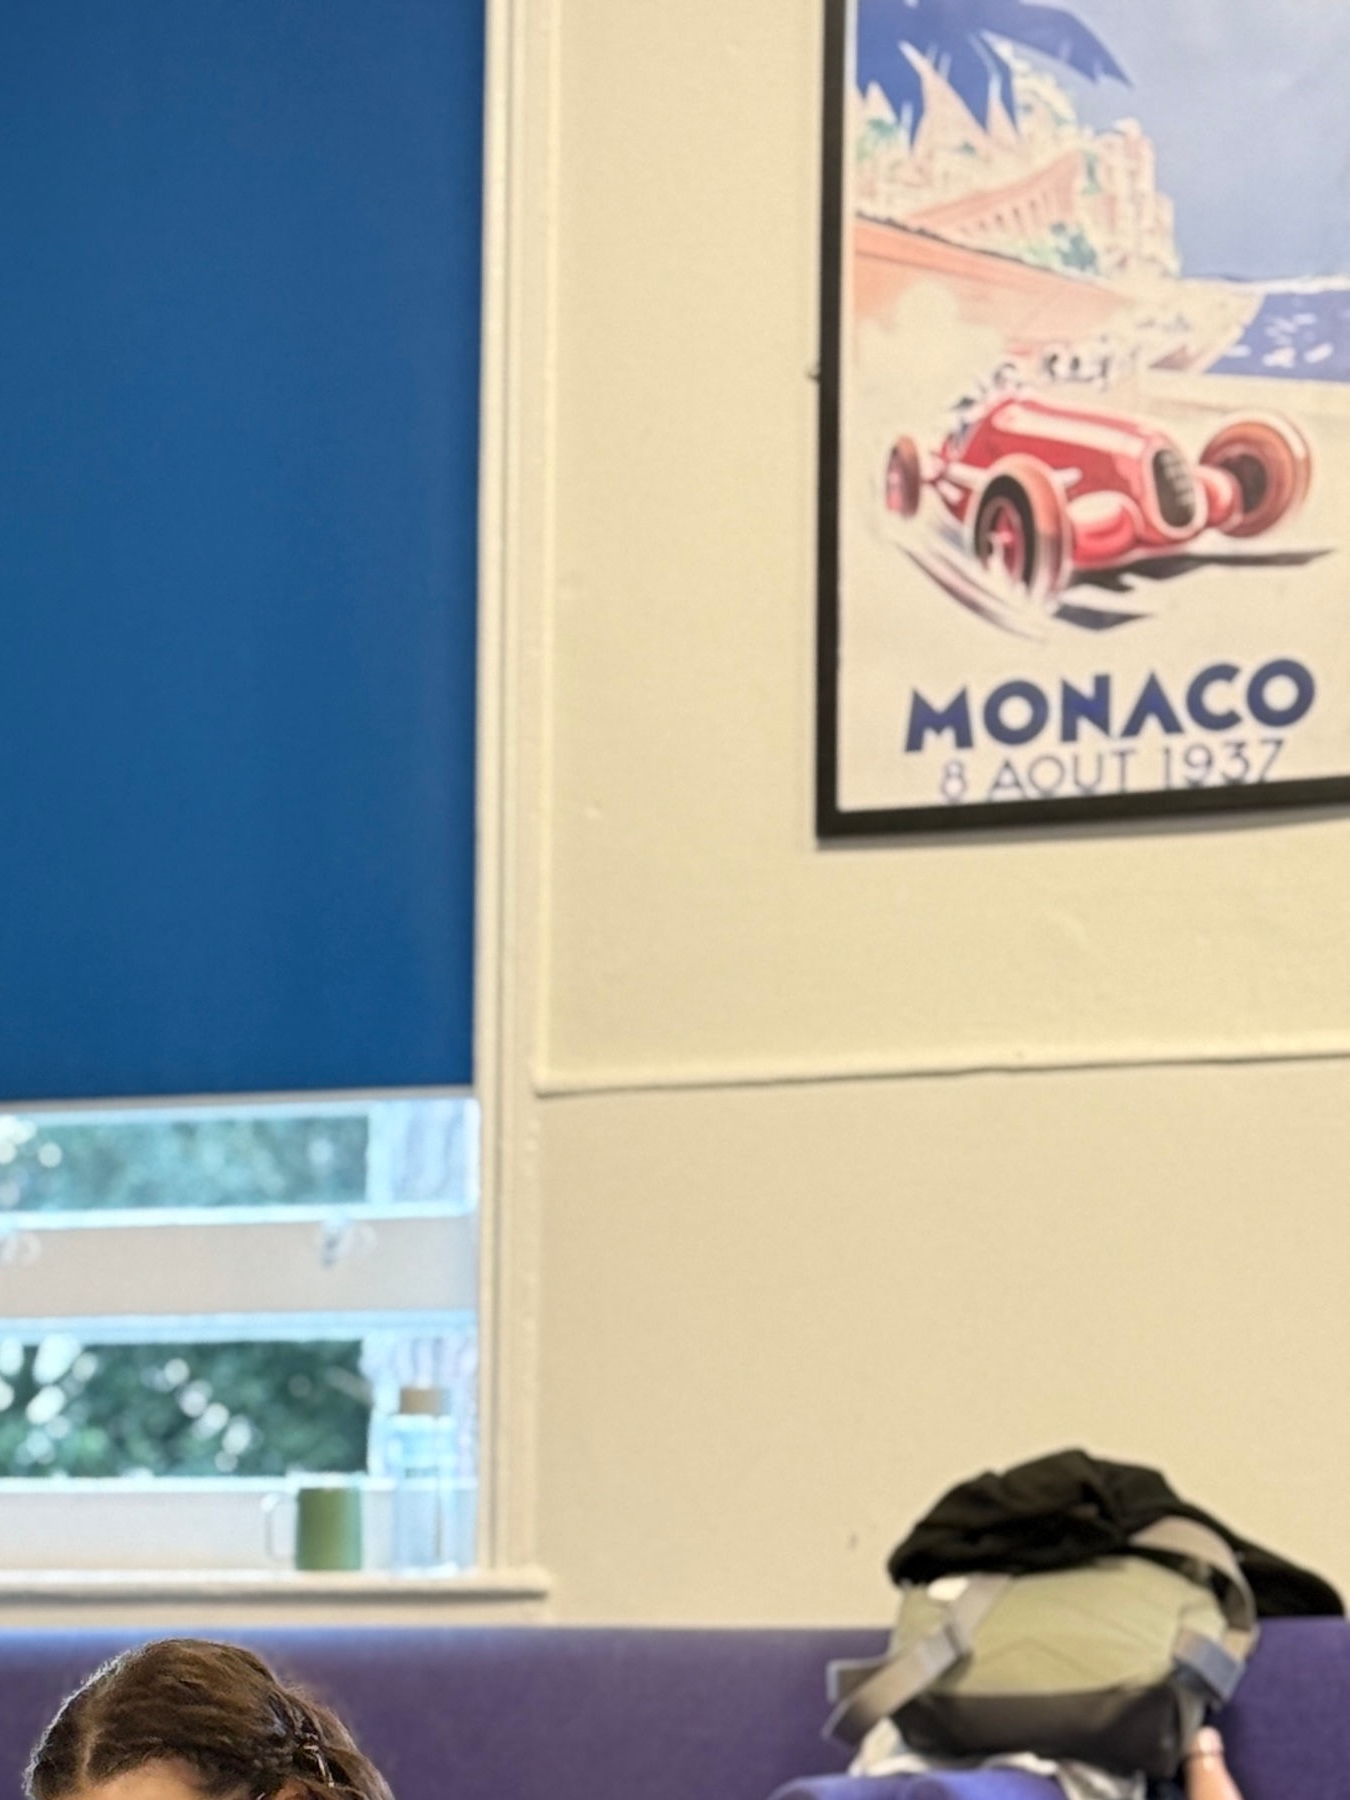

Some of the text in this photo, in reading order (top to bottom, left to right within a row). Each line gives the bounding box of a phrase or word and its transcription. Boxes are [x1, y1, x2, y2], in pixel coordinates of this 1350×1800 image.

[905, 659, 1315, 752] MONACO
[941, 740, 1284, 802] 8 AOUT 1937
